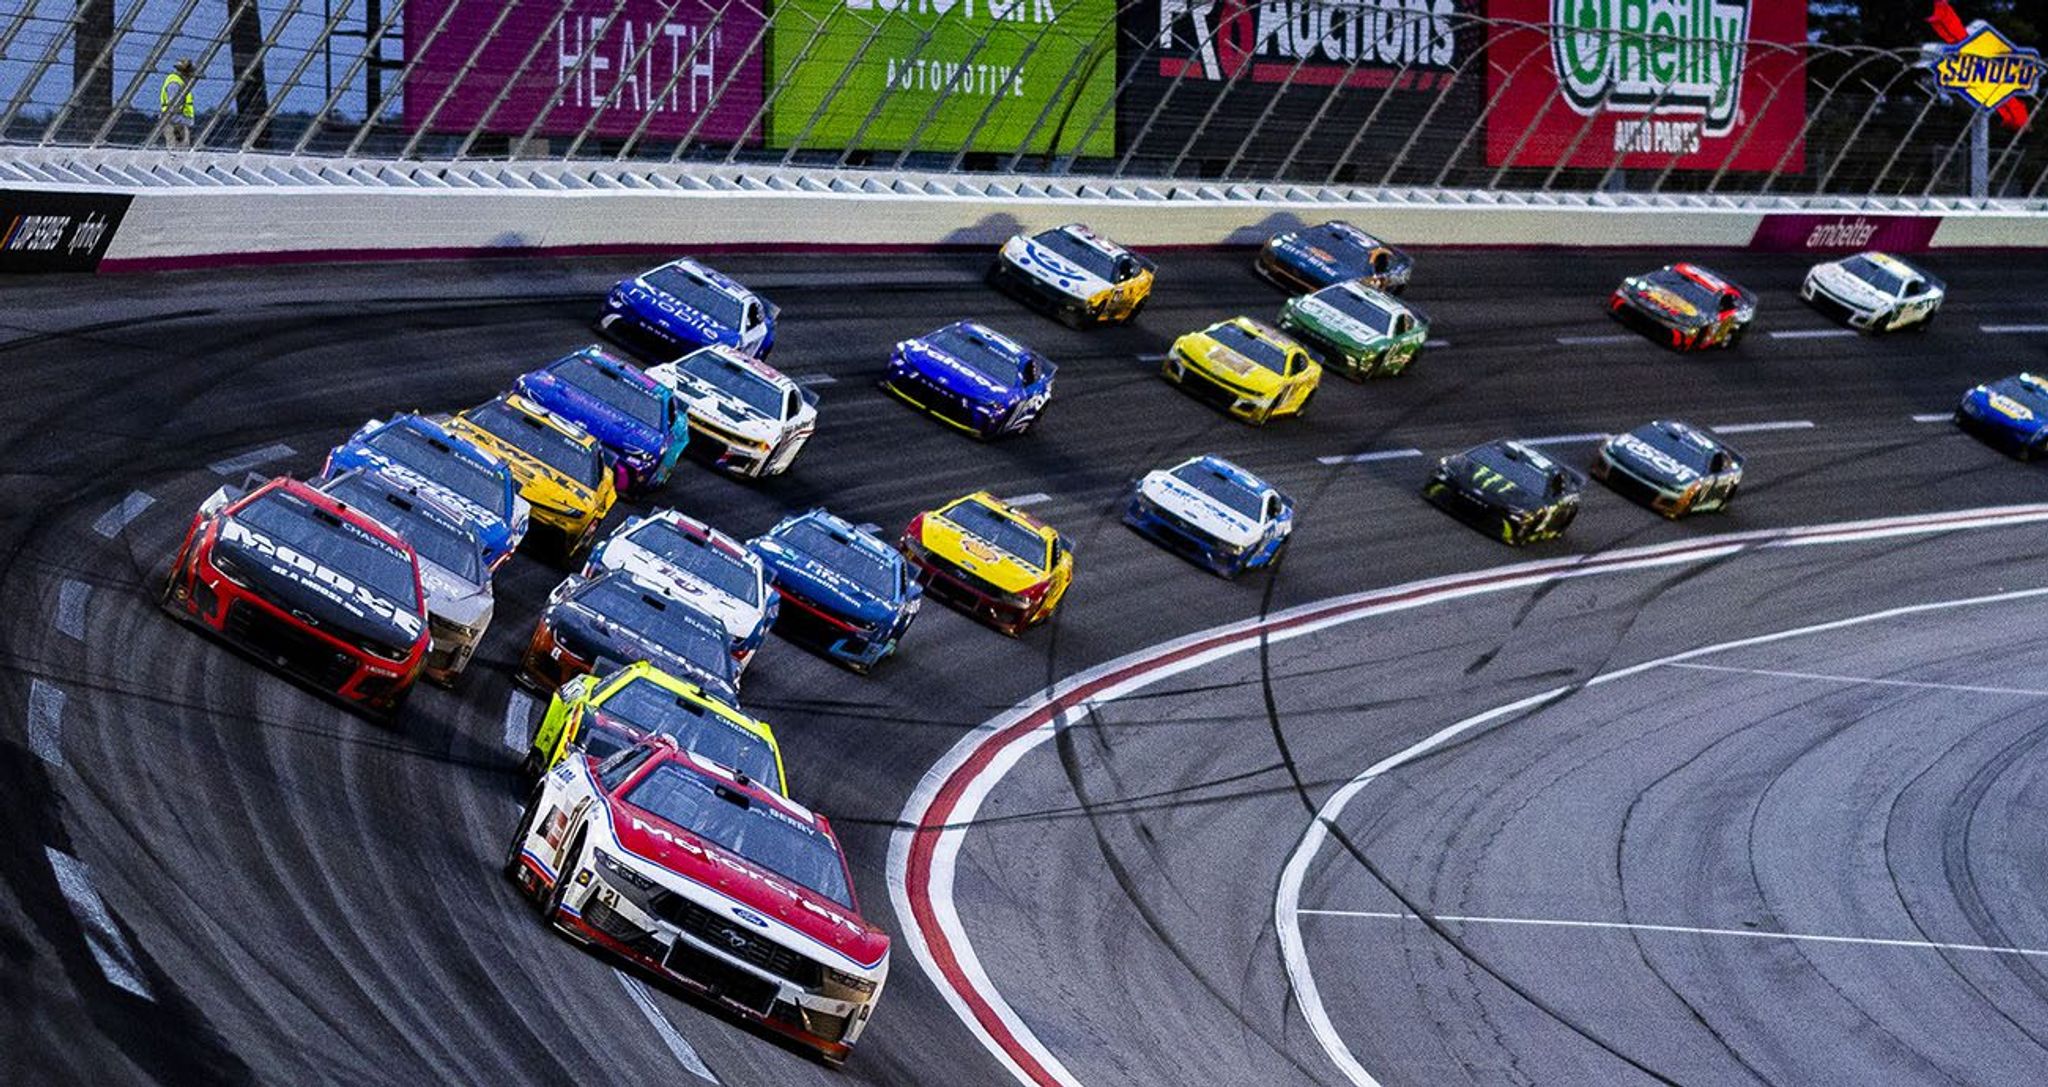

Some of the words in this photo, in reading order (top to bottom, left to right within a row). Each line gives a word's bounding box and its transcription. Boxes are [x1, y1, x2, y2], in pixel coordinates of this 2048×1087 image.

[559, 16, 714, 112] HEALTH
[885, 58, 1024, 97] AUTOMOTIVE
[1944, 54, 2034, 85] SUNOCO
[1614, 120, 1651, 152] AUTO
[1655, 121, 1700, 154] PARTS
[1806, 217, 1878, 248] ambetter
[629, 288, 719, 341] mobile
[454, 451, 495, 477] LARSON
[422, 509, 464, 536] BLANEY
[342, 522, 411, 563] CHASTAIN
[769, 808, 816, 837] BERRY
[631, 816, 868, 941] Motorcraft
[603, 888, 621, 909] 21
[737, 908, 763, 926] Ford
